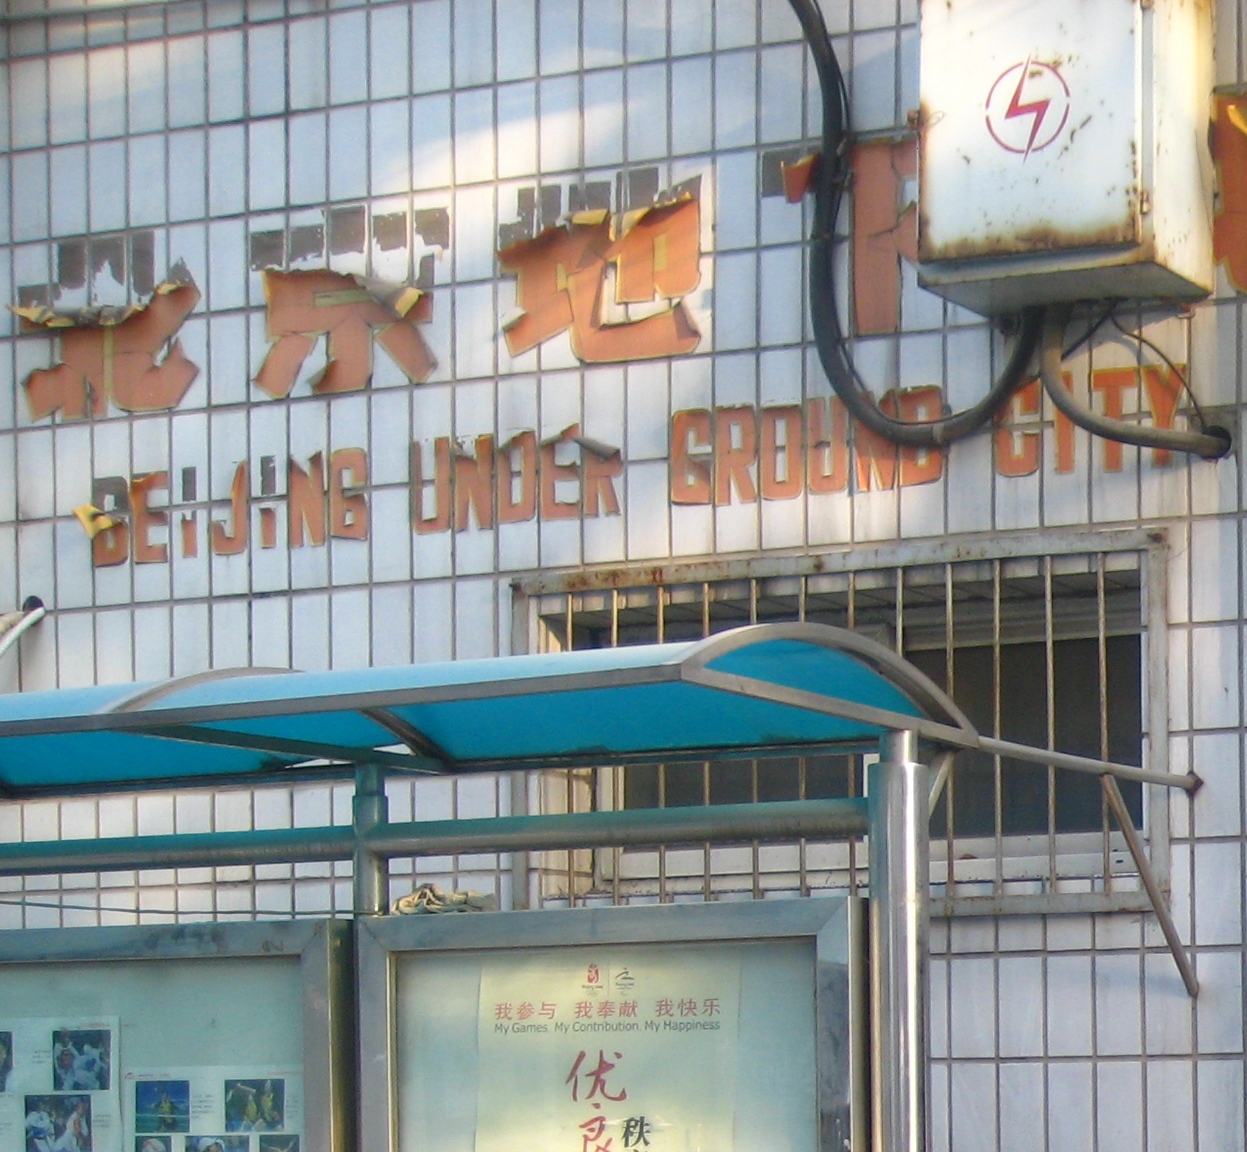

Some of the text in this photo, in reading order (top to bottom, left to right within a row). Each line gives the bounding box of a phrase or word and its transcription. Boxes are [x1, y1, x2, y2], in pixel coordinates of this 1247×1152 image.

[88, 363, 1188, 567] BEIJING UNDER GROUND CITY
[495, 998, 721, 1021] 我参与 我奉献 我快乐
[495, 1023, 509, 1035] My
[554, 1022, 569, 1034] My
[645, 1021, 660, 1032] My
[663, 1020, 721, 1032] Happiness
